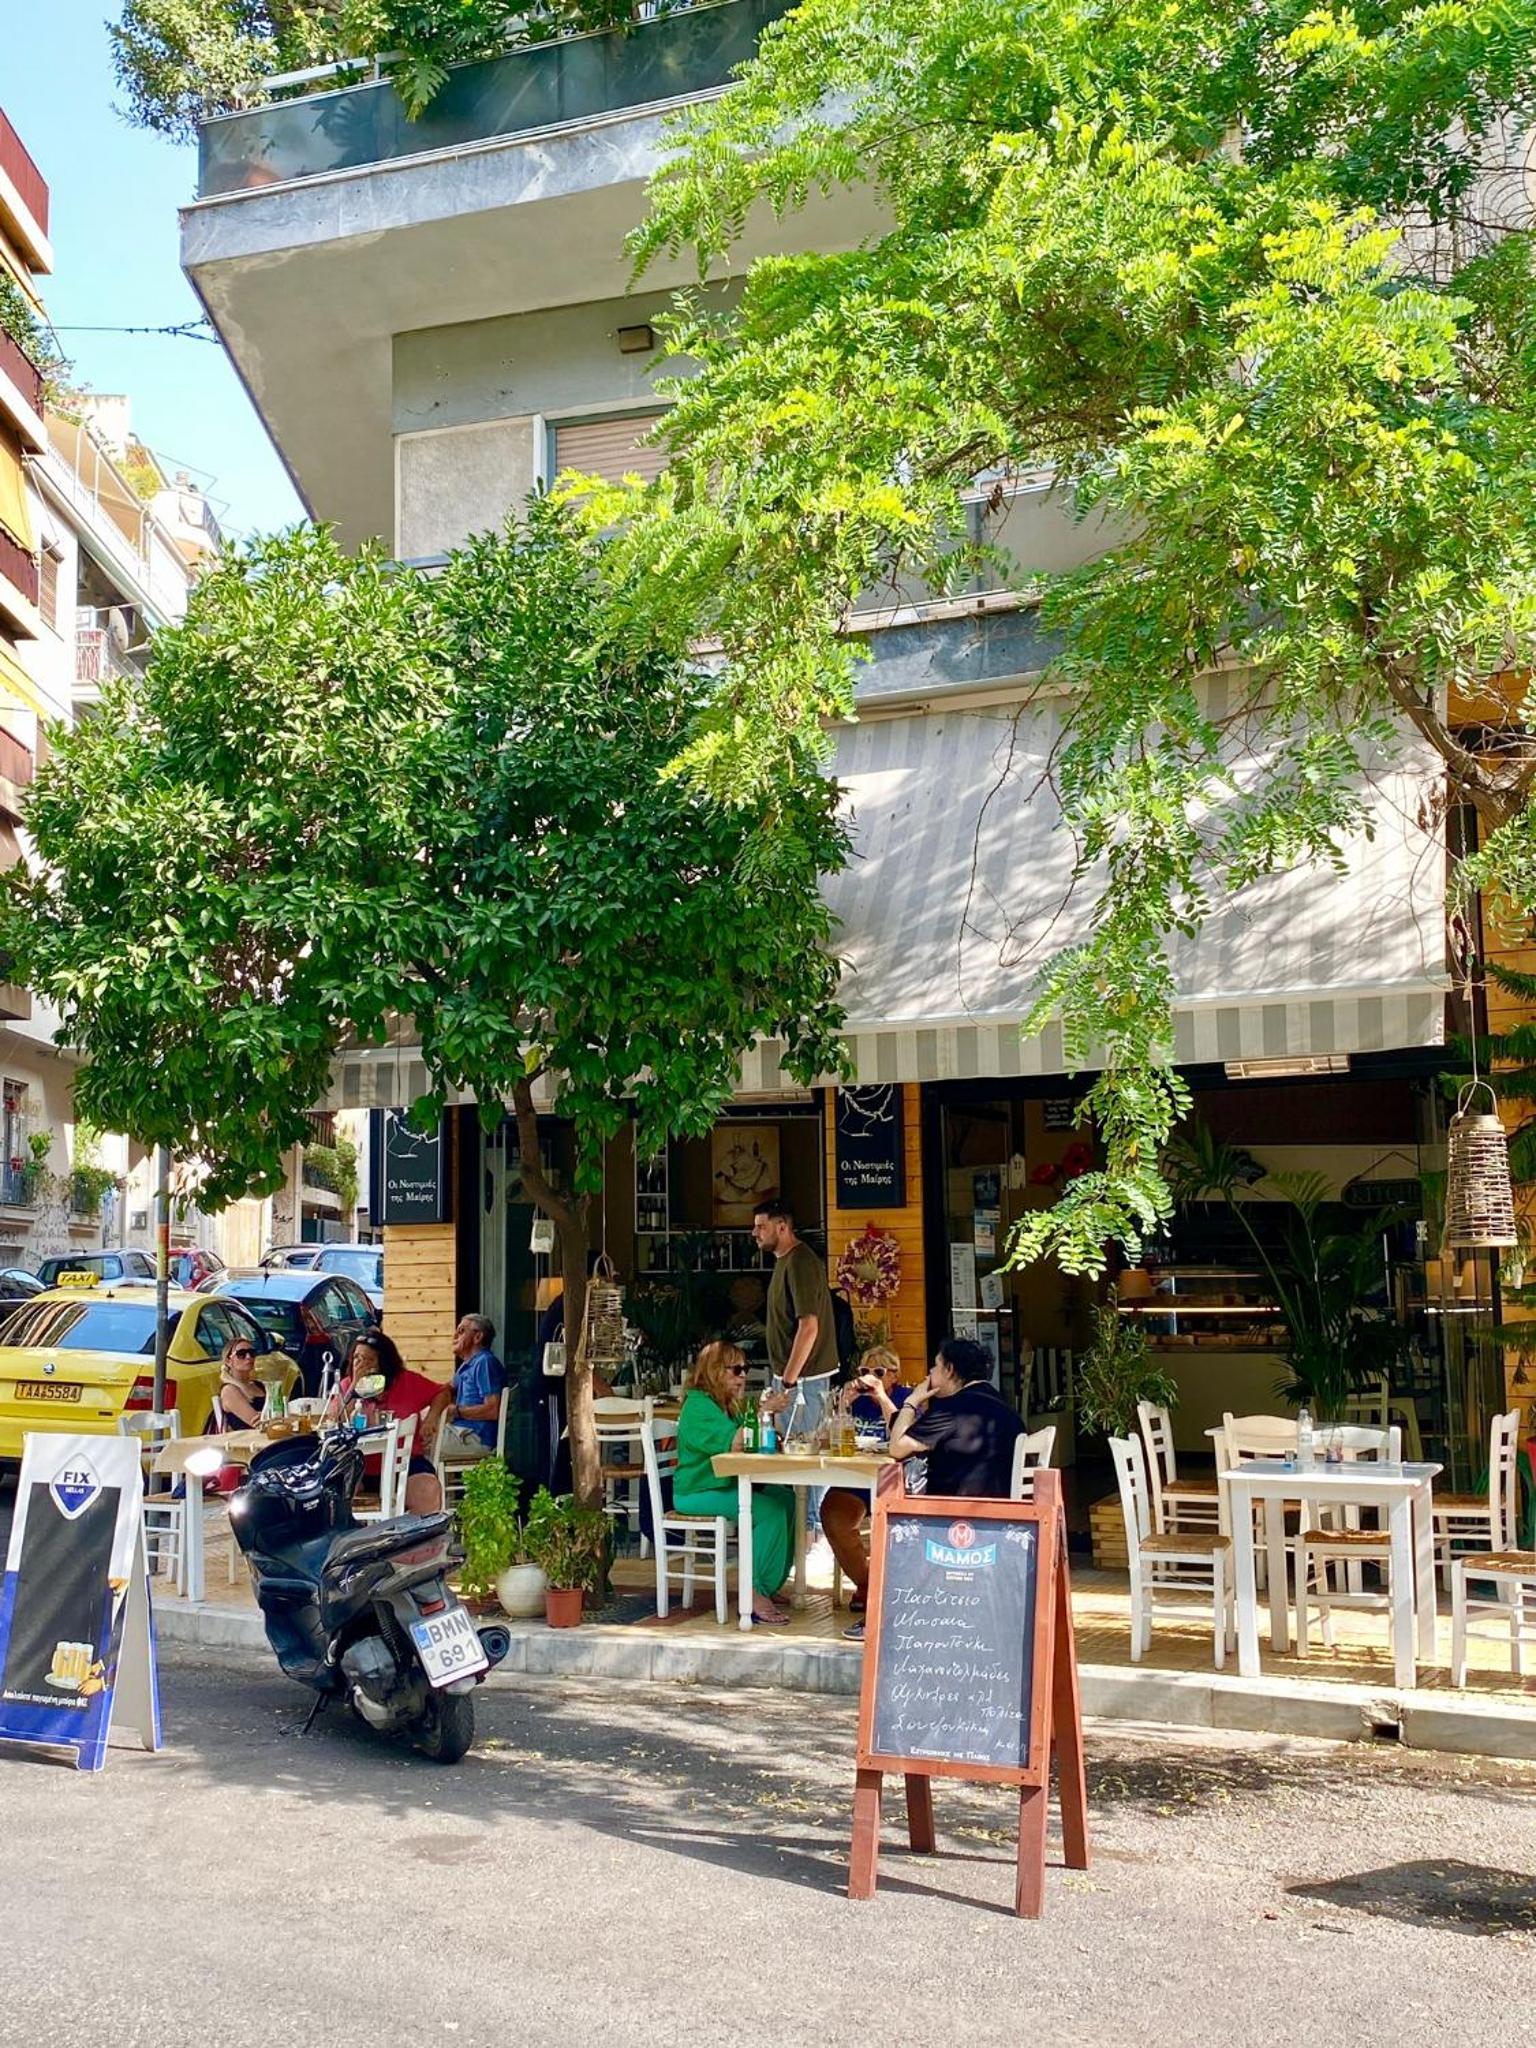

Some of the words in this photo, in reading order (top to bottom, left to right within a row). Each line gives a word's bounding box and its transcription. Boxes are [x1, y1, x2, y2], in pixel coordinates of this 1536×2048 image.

[841, 1160, 851, 1170] Οι
[853, 1160, 894, 1171] Νοστιμιές
[388, 1180, 398, 1189] Οι
[844, 1177, 858, 1185] της
[861, 1174, 892, 1185] Μαίρης
[391, 1195, 403, 1203] της
[405, 1192, 434, 1203] Μαίρης
[61, 1274, 92, 1282] TAXI
[63, 1472, 90, 1484] FIX
[931, 1546, 992, 1565] ΜΑΜΟΣ
[429, 1614, 469, 1643] BMN
[440, 1638, 478, 1667] 691
